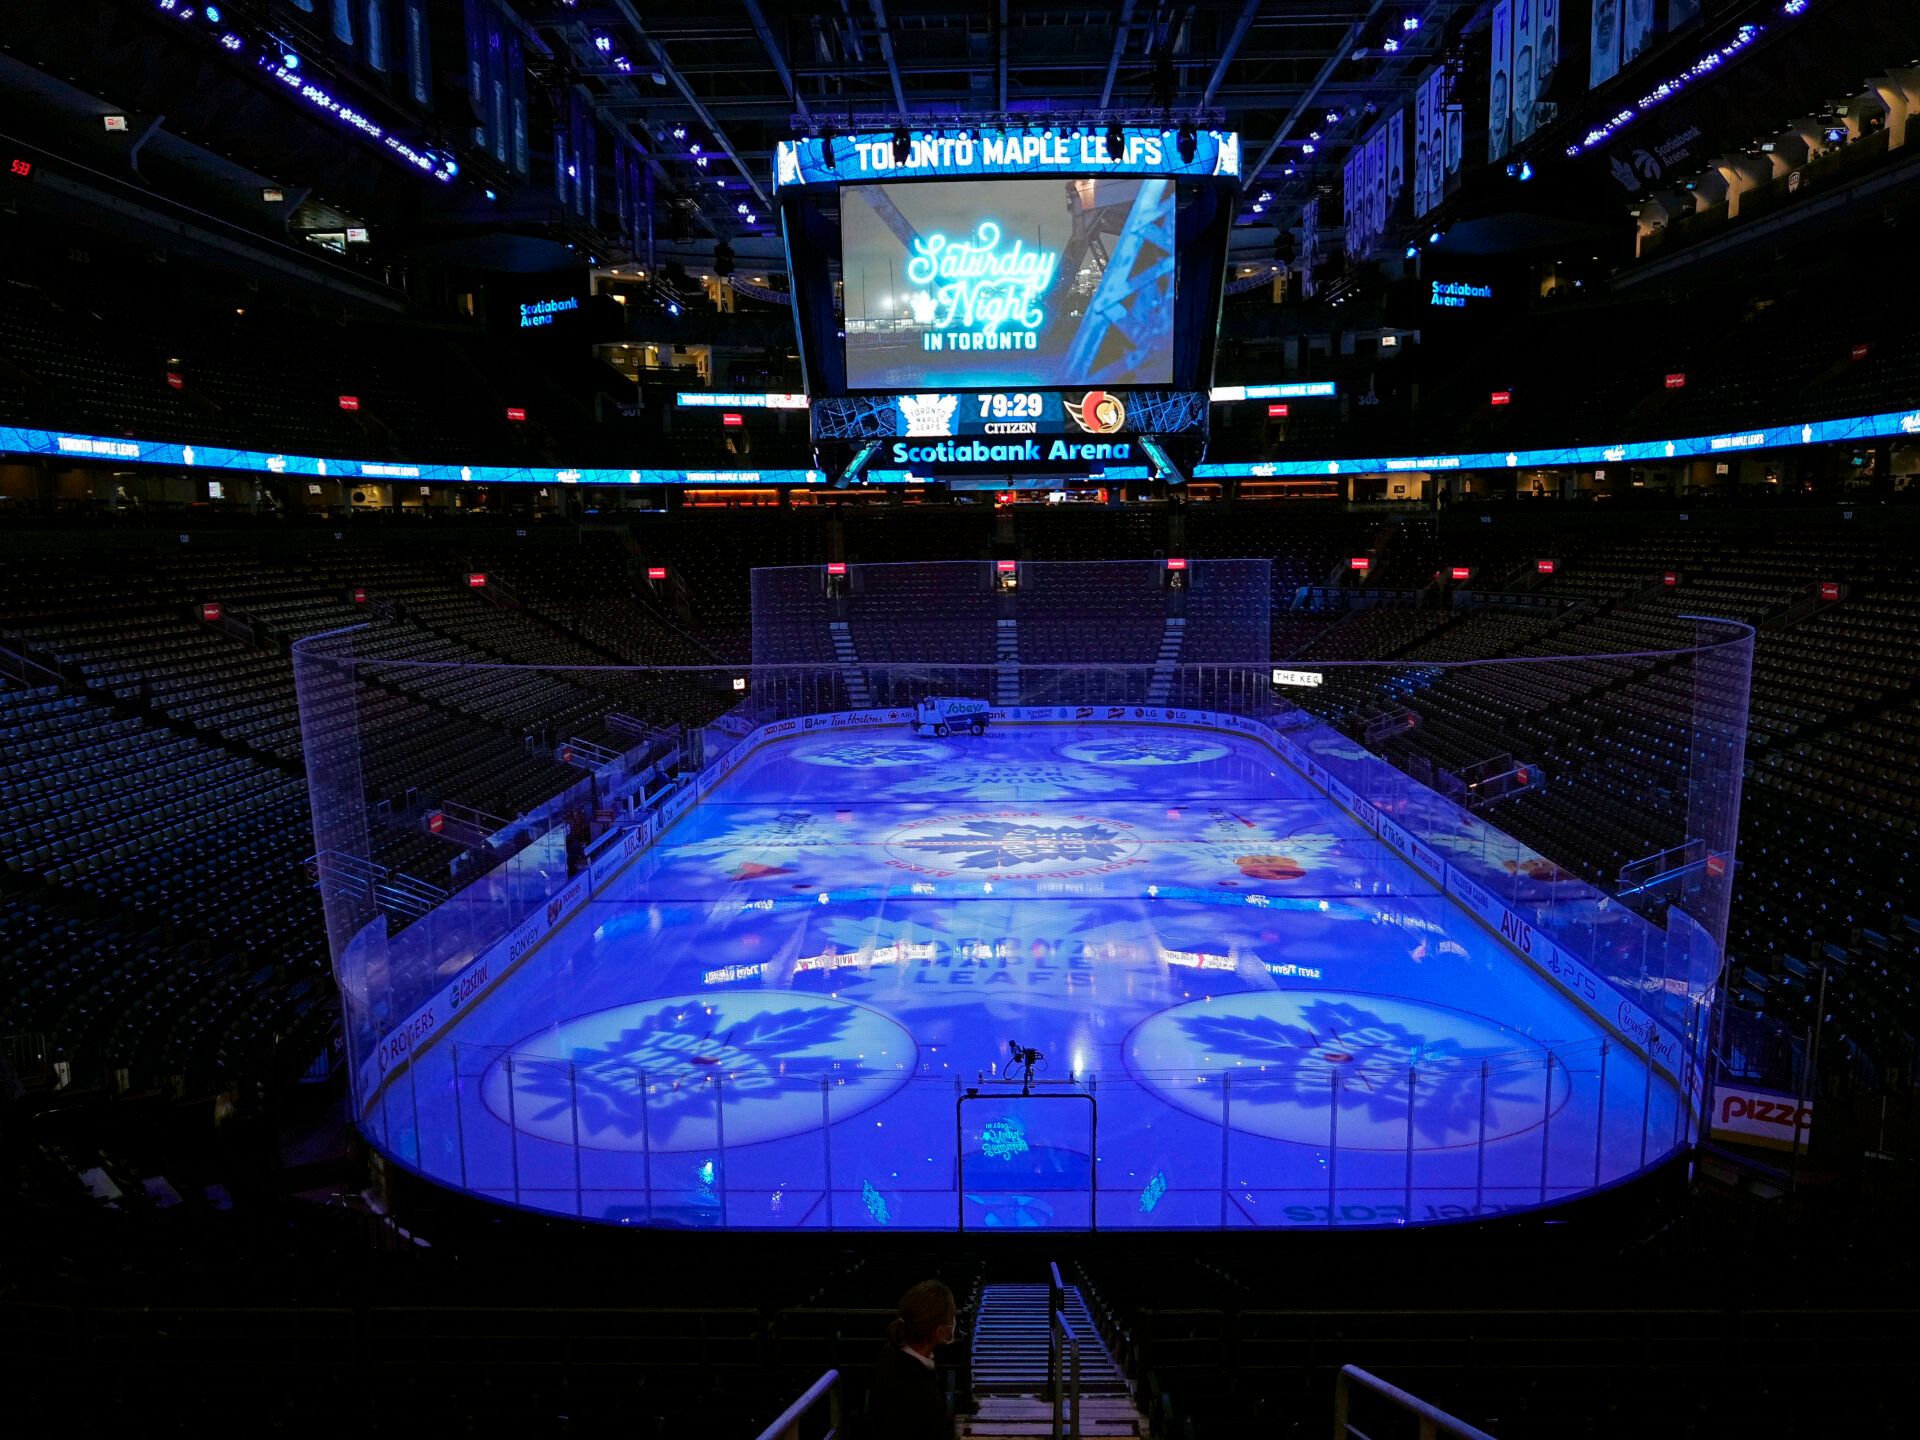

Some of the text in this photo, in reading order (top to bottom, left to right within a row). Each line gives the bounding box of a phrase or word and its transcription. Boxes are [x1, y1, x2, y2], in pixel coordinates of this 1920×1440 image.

[1418, 98, 1425, 136] 5
[1654, 125, 1702, 154] Scotiabank
[855, 138, 972, 171] TOONTO
[983, 136, 1071, 165] MAPLE
[908, 221, 1056, 292] Saturday
[1432, 280, 1492, 298] Scotiabank
[520, 297, 578, 316] Scotiabank
[936, 280, 1043, 337] Night
[1431, 293, 1466, 307] Arena
[520, 314, 552, 327] Arena
[923, 331, 1037, 351] IN TORONTO
[910, 407, 946, 418] TORONTO
[978, 394, 1043, 418] 79:29
[984, 422, 1037, 434] CITIZEN
[893, 440, 1130, 464] Scotiabank Arena
[1843, 511, 1853, 520] 107
[1277, 673, 1319, 684] THE KEG
[946, 703, 984, 714] Sobeys
[1145, 709, 1157, 718] LG
[1175, 711, 1186, 720] LG
[778, 721, 796, 734] pizza
[830, 712, 883, 727] Tim Hortons
[937, 775, 1089, 784] TORONTO
[897, 812, 1135, 829] Scotiabank Arena
[884, 859, 956, 878] Arena
[987, 857, 1147, 881] Scotiabank
[1500, 909, 1531, 953] AVIS
[510, 925, 539, 962] BONVOY
[459, 961, 488, 1001] Castrol
[914, 970, 1094, 987] LEAFS
[1563, 960, 1597, 1000] PS5
[1618, 1000, 1676, 1064] Crown Ryal
[641, 1031, 776, 1090] TORONTO
[1283, 1205, 1405, 1222] Eats
